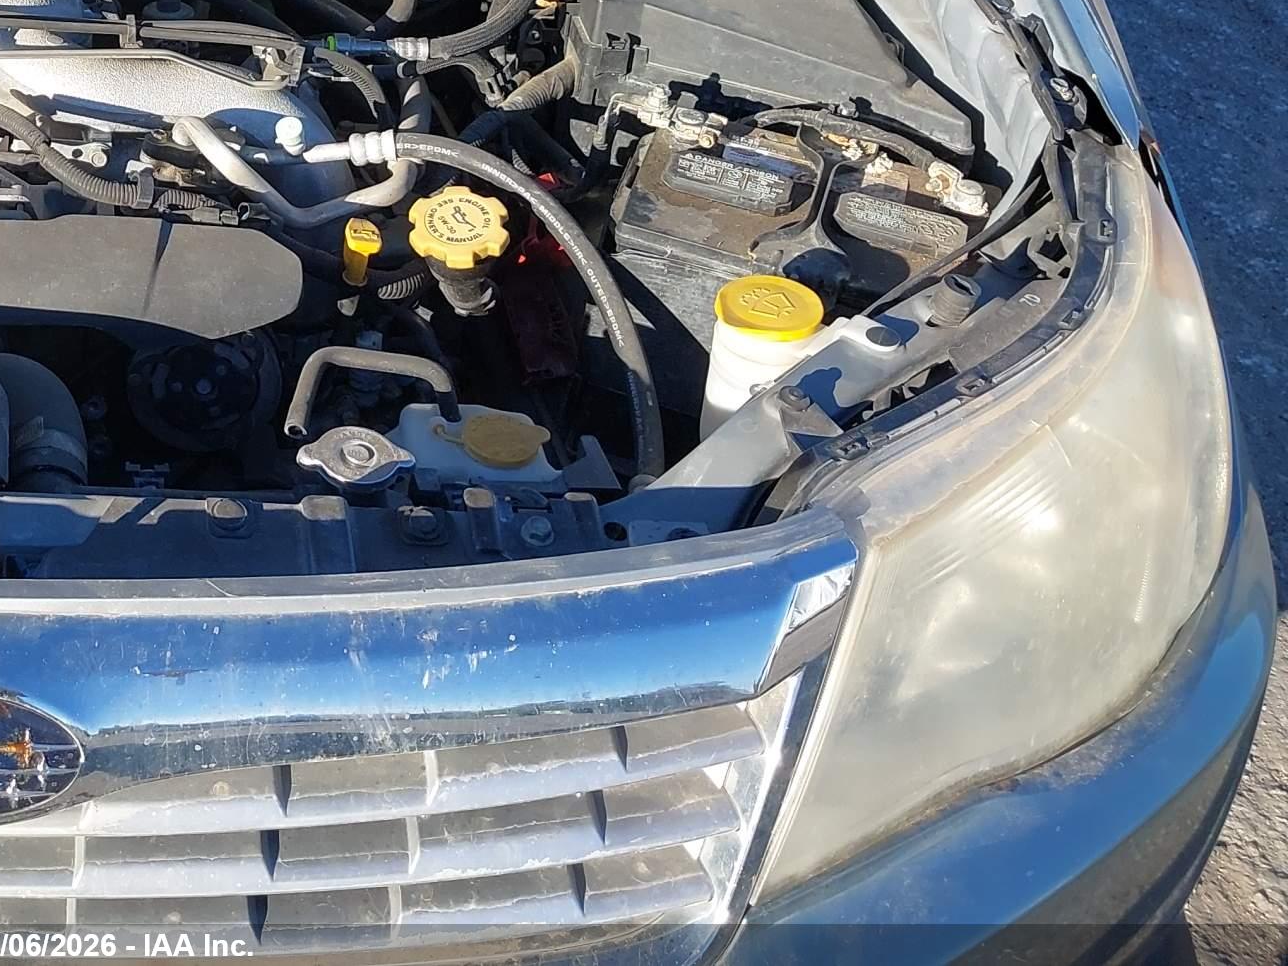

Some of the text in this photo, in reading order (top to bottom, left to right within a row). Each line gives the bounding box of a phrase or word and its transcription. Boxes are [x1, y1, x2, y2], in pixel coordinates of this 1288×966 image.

[436, 198, 454, 208] SEE
[445, 232, 484, 243] MANUAL
[437, 215, 457, 235] 5W-30
[458, 197, 491, 229] ENGINE OIL
